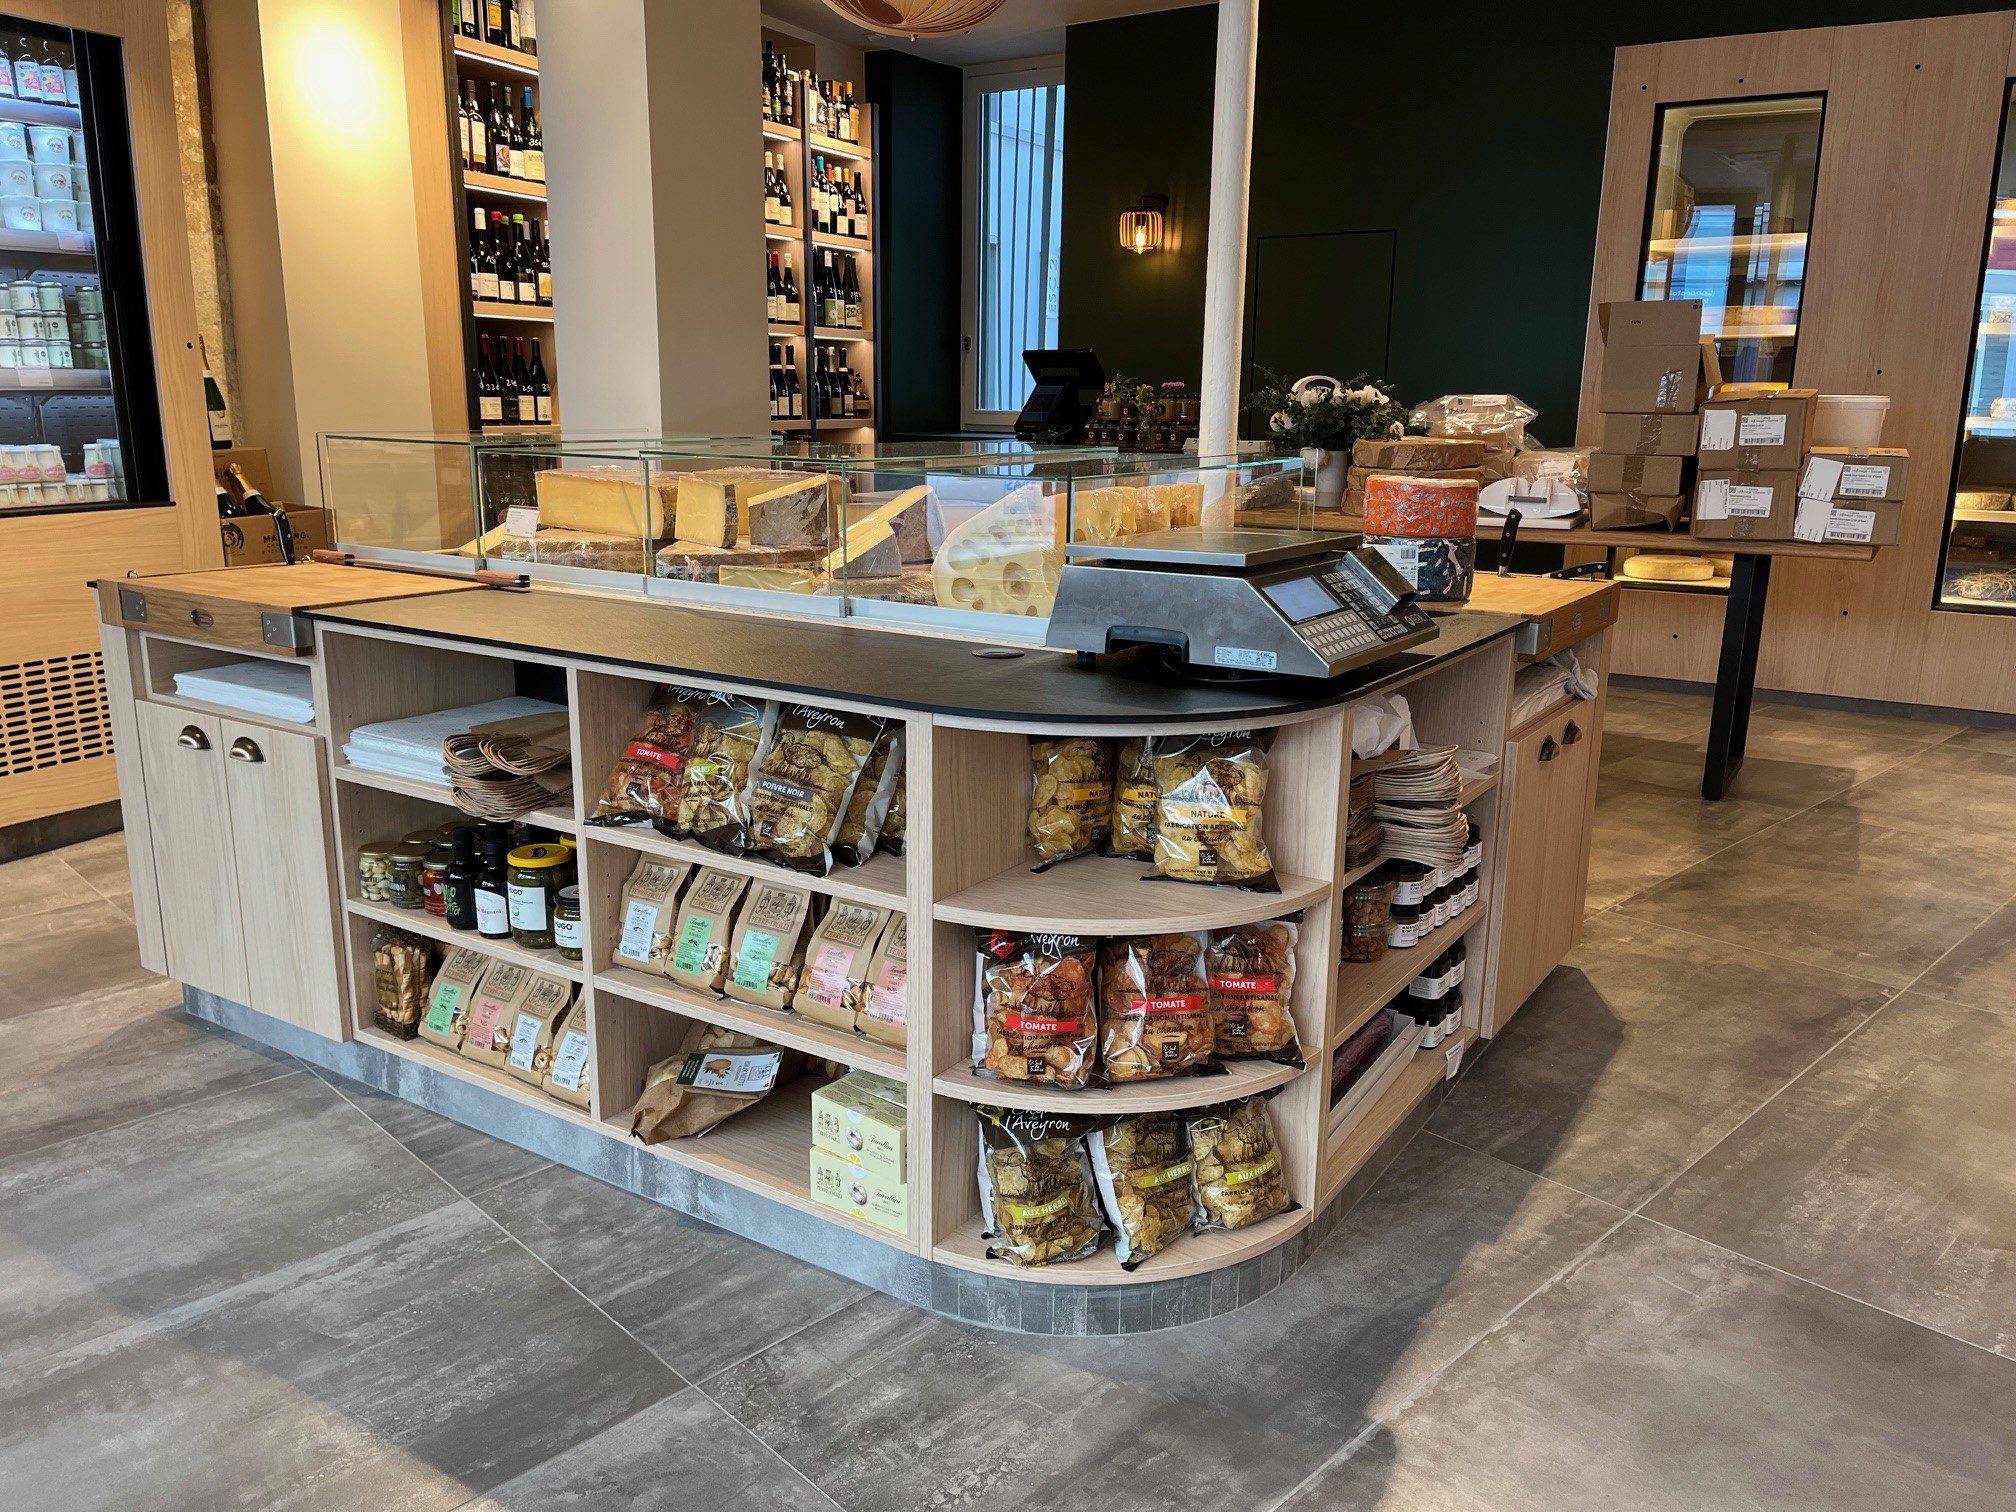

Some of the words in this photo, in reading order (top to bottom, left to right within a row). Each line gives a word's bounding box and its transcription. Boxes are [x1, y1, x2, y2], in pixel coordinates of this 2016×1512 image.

[792, 704, 845, 729] l'Aveyron
[636, 748, 662, 761] TOMATE
[761, 780, 787, 793] POIVRE
[786, 787, 805, 798] NOIR
[1089, 788, 1109, 798] NATU
[1137, 791, 1158, 799] NATU
[1190, 809, 1226, 818] NATURE
[1164, 821, 1209, 830] FABRICATION
[1220, 980, 1257, 989] TOMATE
[1150, 1000, 1186, 1009] TOMATE
[1171, 1012, 1206, 1020] ARTISANALE
[1020, 1020, 1057, 1031] TOMATE
[1005, 1115, 1070, 1140] l'Aveyron
[1237, 1172, 1254, 1182] AUX
[1254, 1159, 1276, 1176] HERBES
[1154, 1174, 1167, 1184] AUX
[1022, 1208, 1041, 1217] AUX
[1041, 1197, 1068, 1215] HERBE
